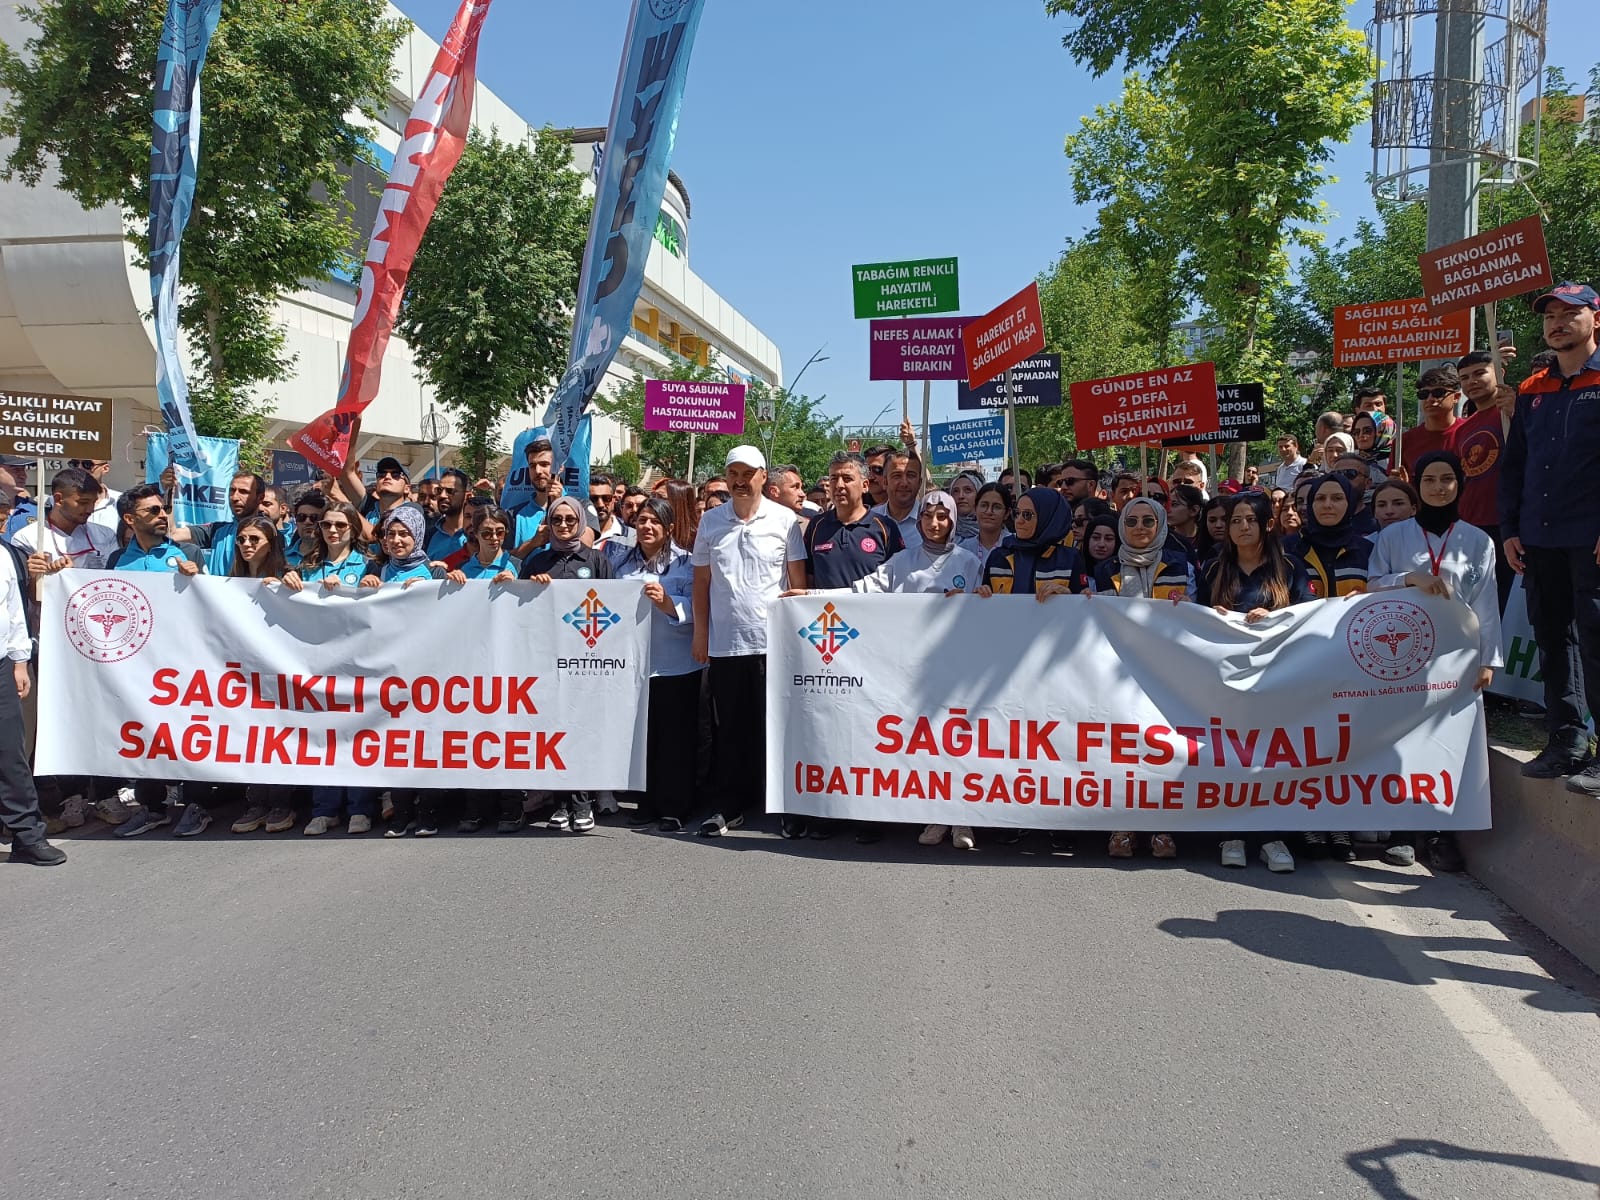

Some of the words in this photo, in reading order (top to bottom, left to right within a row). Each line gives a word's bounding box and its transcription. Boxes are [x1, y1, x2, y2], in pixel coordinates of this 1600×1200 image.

[1435, 231, 1525, 271] TEKNOLOJİYE
[857, 265, 910, 282] TABAĞIM
[913, 263, 955, 278] RENKLİ
[1443, 252, 1521, 286] BAĞLANMA
[881, 281, 932, 296] HAYATIM
[1431, 282, 1481, 307] HAYATA
[1484, 264, 1543, 290] BAĞLAN
[877, 293, 937, 312] HAREKETLİ
[1345, 306, 1406, 320] SAĞLIKLI
[873, 330, 909, 341] NEFES
[912, 329, 954, 341] ALMAK
[976, 314, 1015, 349] HAREKET
[1015, 306, 1027, 323] ET
[1359, 320, 1387, 335] İÇİN
[972, 337, 1012, 371] SAĞLIKLI
[1012, 321, 1037, 344] YAŞA
[1343, 329, 1459, 349] TARAMALARINIZI
[900, 343, 956, 357] SİGARAYI
[1340, 350, 1383, 363] İHMAL
[1388, 341, 1462, 359] ETMEYİNİZ
[903, 360, 953, 372] BIRAKIN
[661, 383, 686, 393] SUYA
[689, 384, 729, 395] SABUNA
[1091, 376, 1144, 396] GÜNDE
[1149, 374, 1168, 387] EN
[1173, 370, 1193, 384] AZ
[669, 396, 721, 407] DOKUNUN
[1118, 396, 1128, 408] 2
[1132, 390, 1169, 406] DEFA
[1227, 389, 1240, 399] VE
[52, 398, 103, 412] HAYAT
[652, 407, 736, 419] HASTALIKLARDAN
[2, 409, 75, 425] SAĞLIKLI
[1102, 401, 1188, 426] DİŞLERİNİZİ
[1219, 412, 1261, 426] EBZELERİ
[669, 420, 719, 431] KORUNUN
[948, 419, 993, 432] HAREKETE
[1098, 418, 1196, 443] FIRÇALAYINIZ
[942, 428, 1002, 444] ÇOCUKLUKTA
[13, 441, 64, 456] GEÇER
[937, 442, 966, 454] BAŞLA
[962, 450, 985, 460] YAŞA
[557, 658, 626, 670] BATMAN
[793, 674, 864, 688] BATMAN
[148, 662, 365, 713] SAĞLIKLI
[379, 675, 540, 719] ÇOCUK
[1332, 690, 1369, 699] BATMAN
[1370, 689, 1376, 697] İL
[1378, 685, 1405, 696] SAĞLIK
[1406, 680, 1458, 693] MÜDÜRLÜĞÜ
[118, 715, 337, 767] SAĞLIKLI
[352, 728, 568, 771] GELECEK
[874, 708, 1062, 762] SAĞLIK
[1076, 713, 1352, 769] FESTİVALİ
[794, 760, 952, 802] (BATMAN
[962, 768, 1113, 809] SAĞLIĞI
[1125, 771, 1185, 810] İLE
[1196, 769, 1454, 811] BULUŞUYOR)
